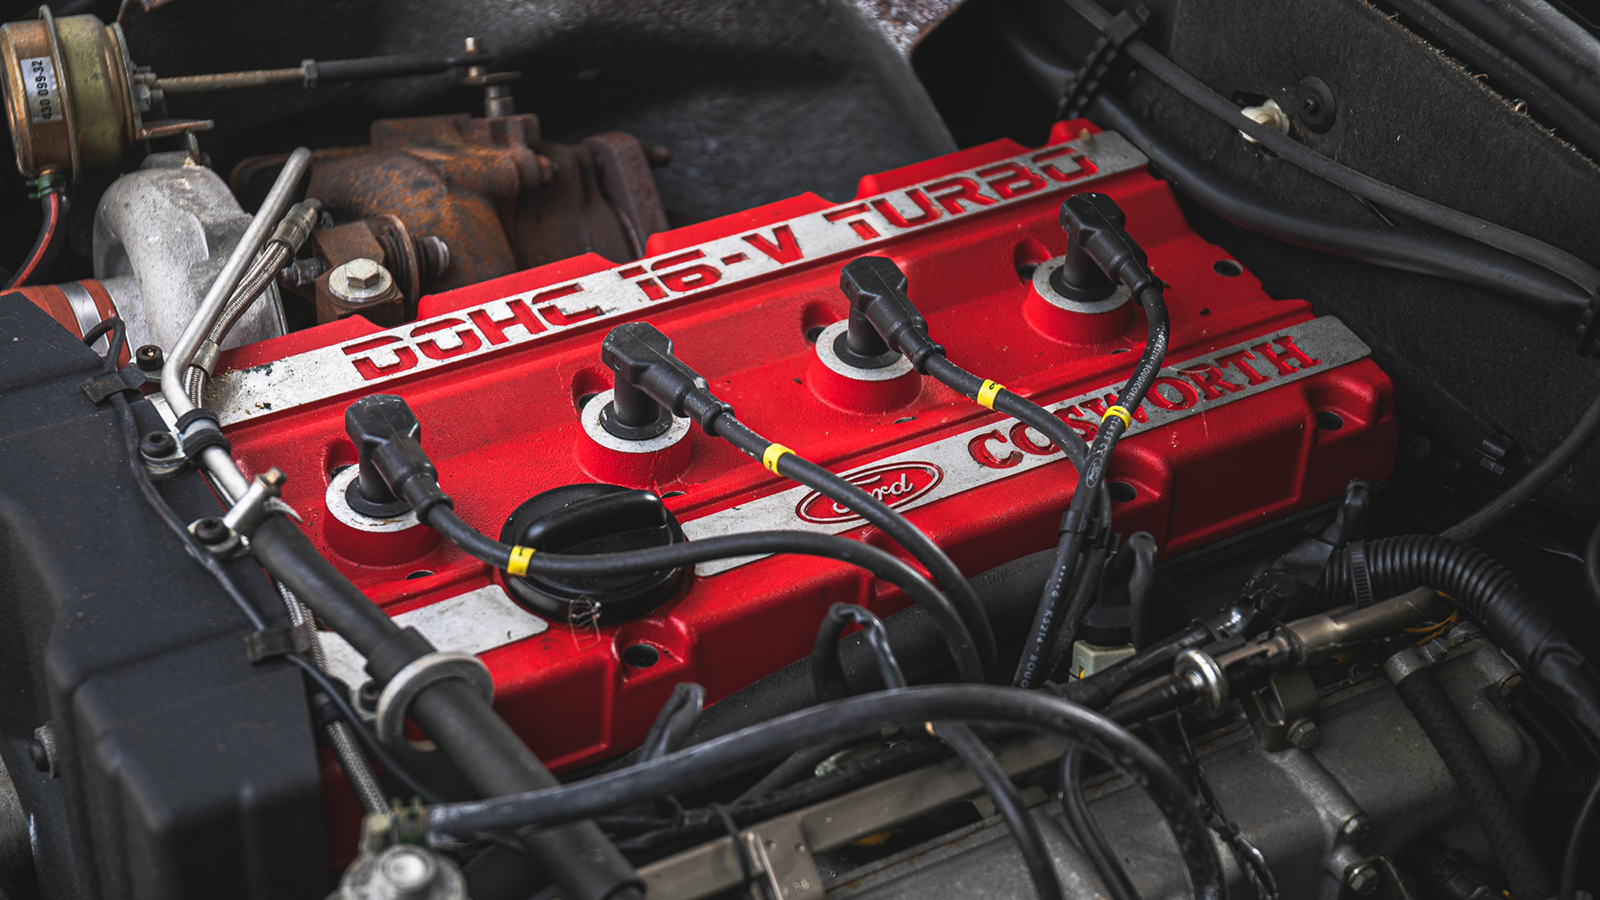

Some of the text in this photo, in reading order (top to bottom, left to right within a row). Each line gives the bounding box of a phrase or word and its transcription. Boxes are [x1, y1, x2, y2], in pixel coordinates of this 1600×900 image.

[31, 60, 53, 119] 430 099-32
[341, 146, 1099, 380] DOHC 16-V TURBO
[1104, 416, 1121, 441] CLASS
[832, 473, 914, 514] Frd
